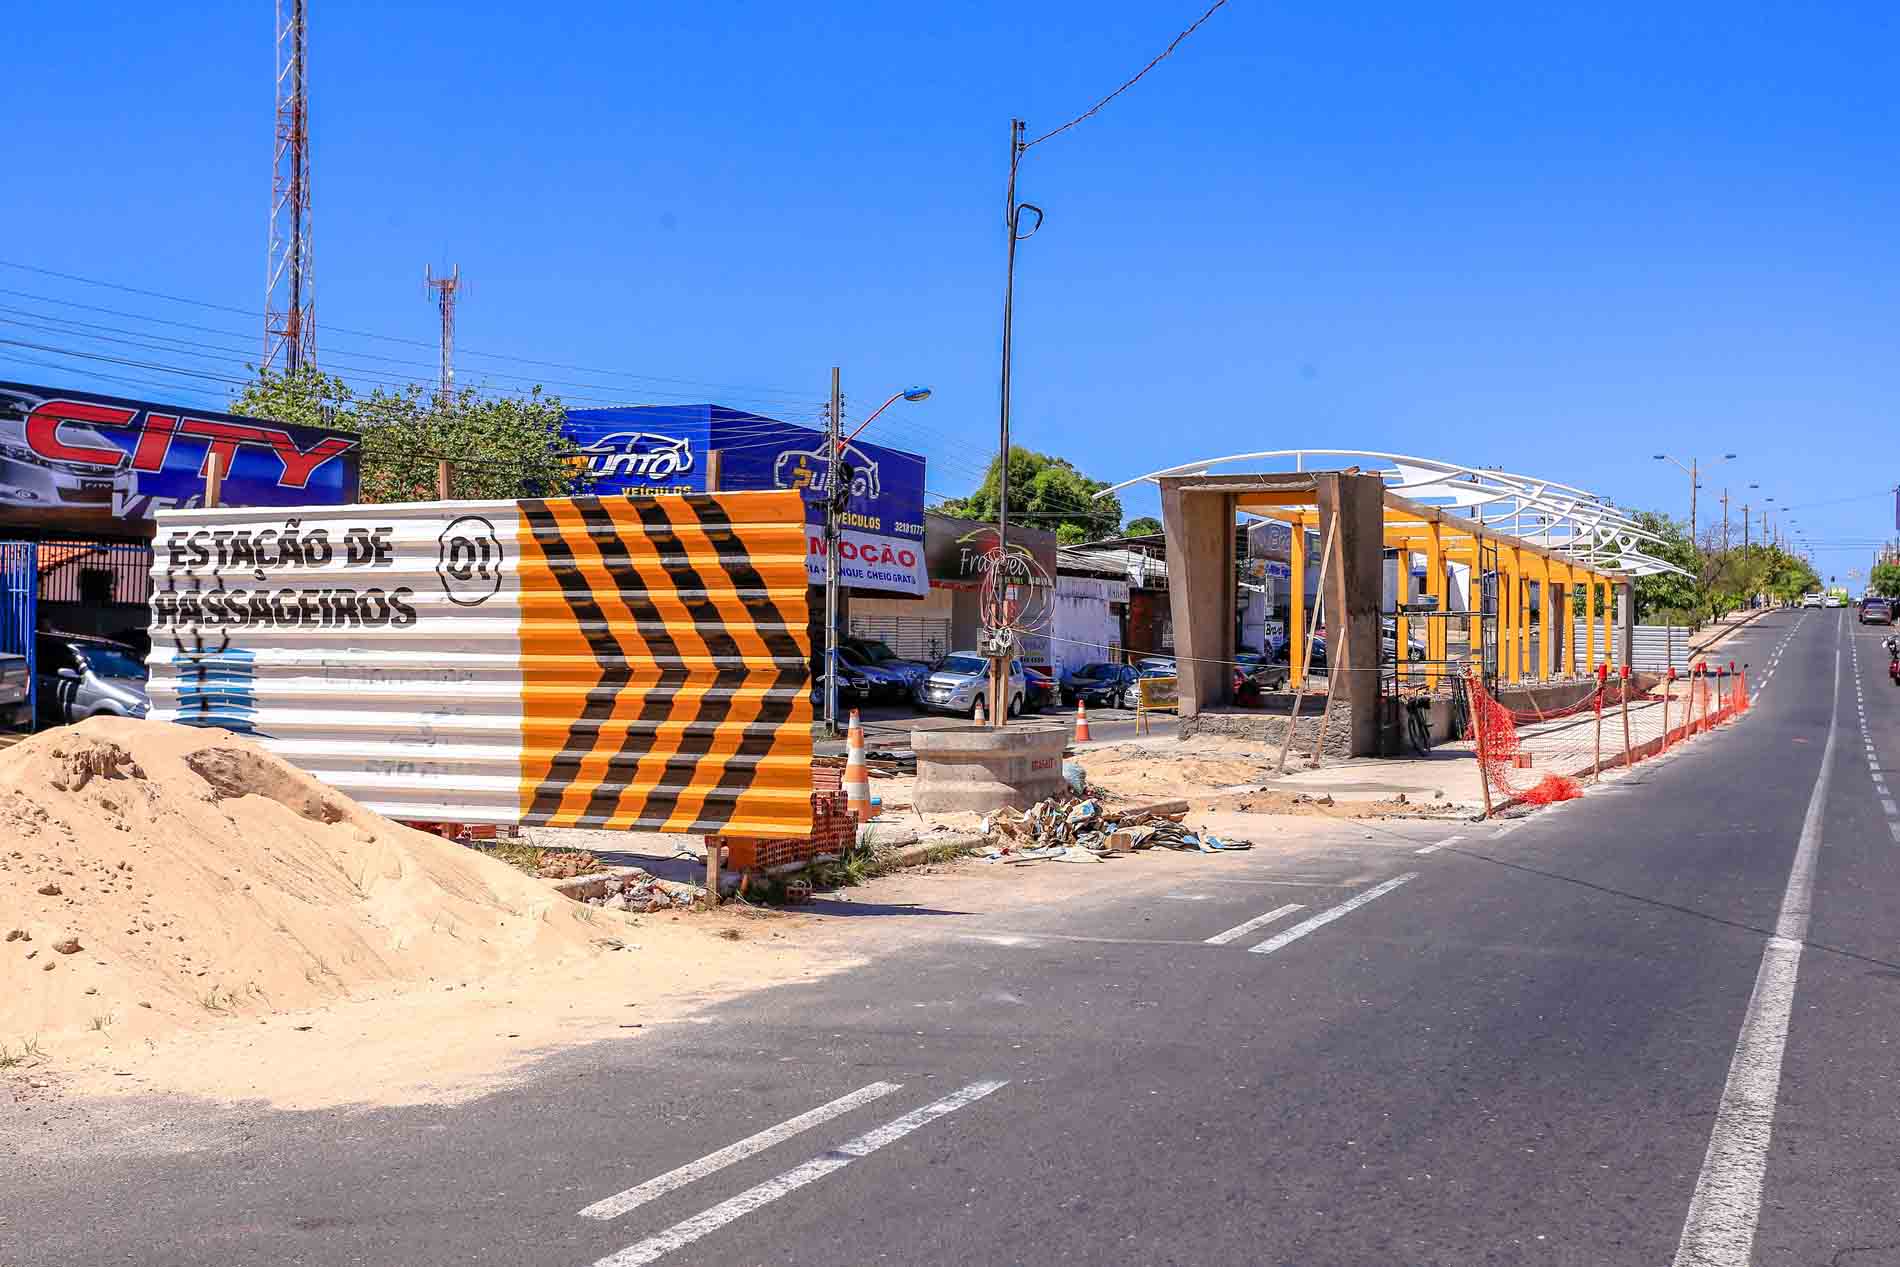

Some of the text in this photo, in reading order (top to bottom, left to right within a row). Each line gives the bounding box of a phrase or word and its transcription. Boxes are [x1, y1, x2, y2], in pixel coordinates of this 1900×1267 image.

[25, 399, 360, 489] CITY
[167, 518, 394, 581] ESTAÇÃO DE
[447, 536, 491, 580] 01
[154, 587, 417, 629] PASSAGEIROS
